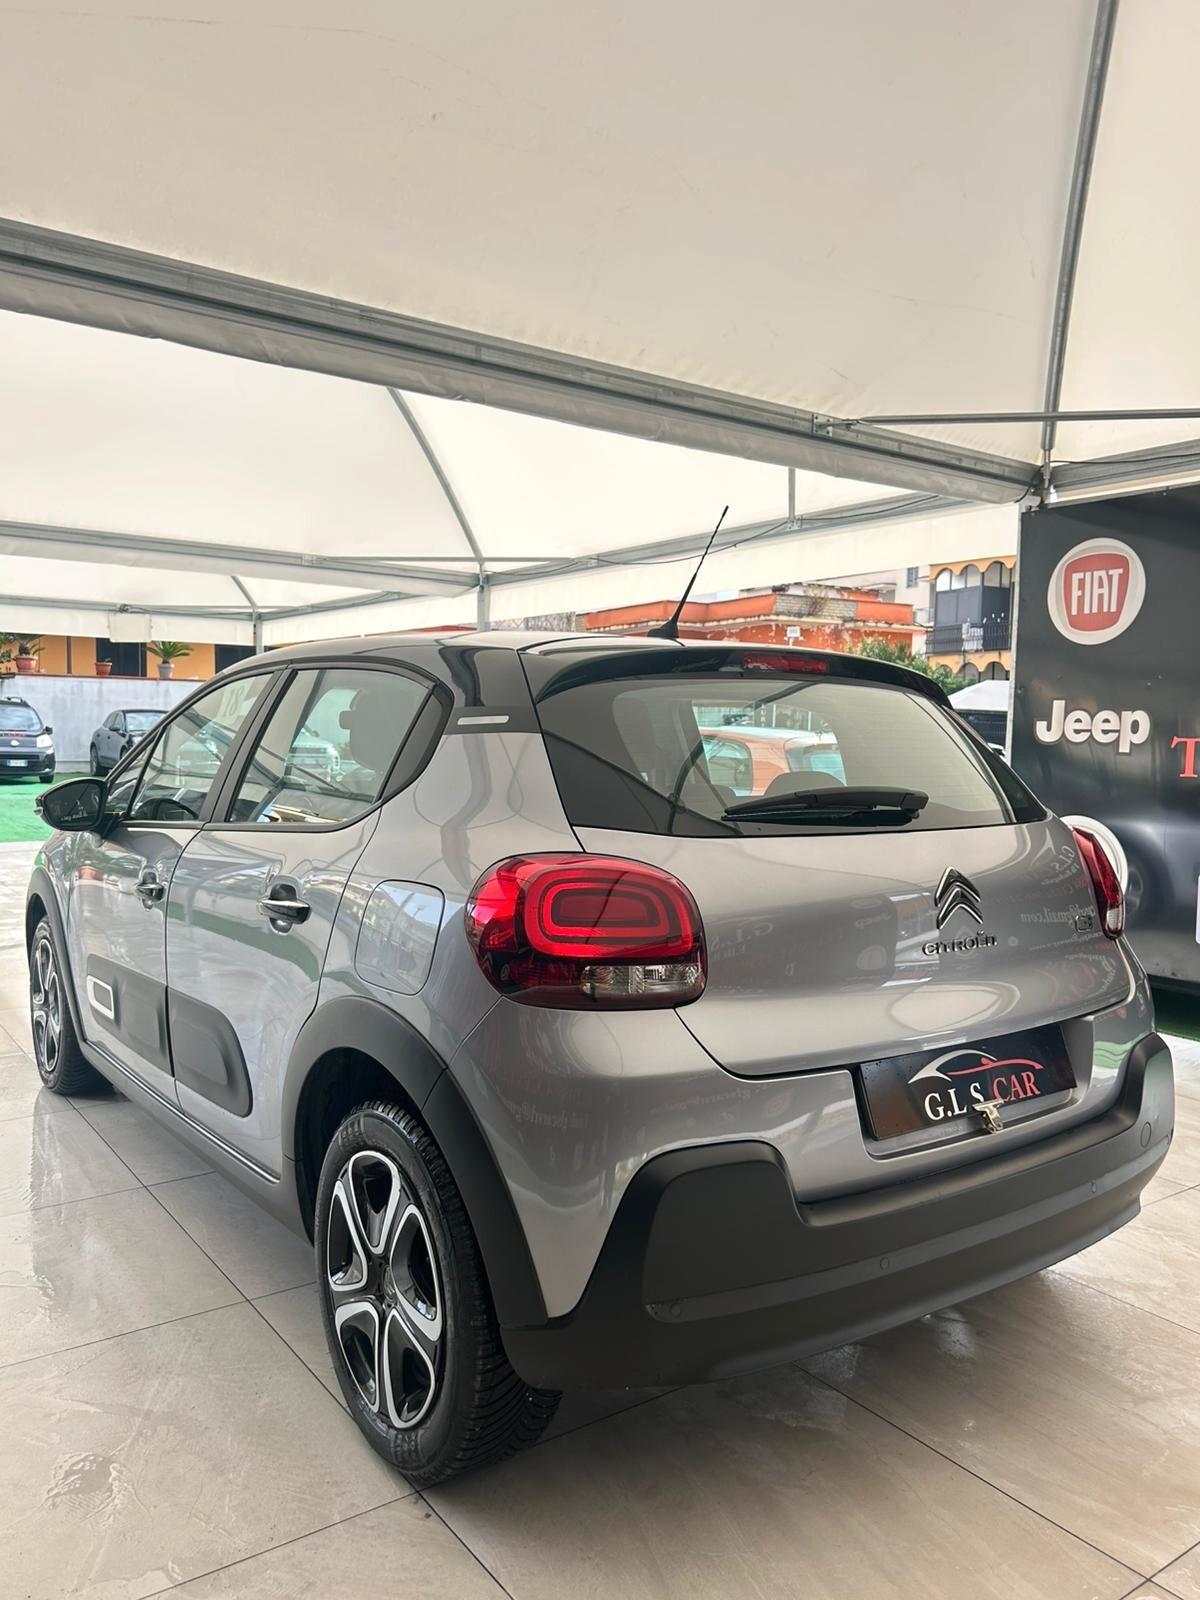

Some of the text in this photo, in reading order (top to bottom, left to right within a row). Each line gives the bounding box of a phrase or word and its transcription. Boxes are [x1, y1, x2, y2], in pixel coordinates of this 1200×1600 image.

[1071, 568, 1124, 616] FIAT
[1035, 699, 1150, 754] Jeep
[993, 1070, 1041, 1104] CAR
